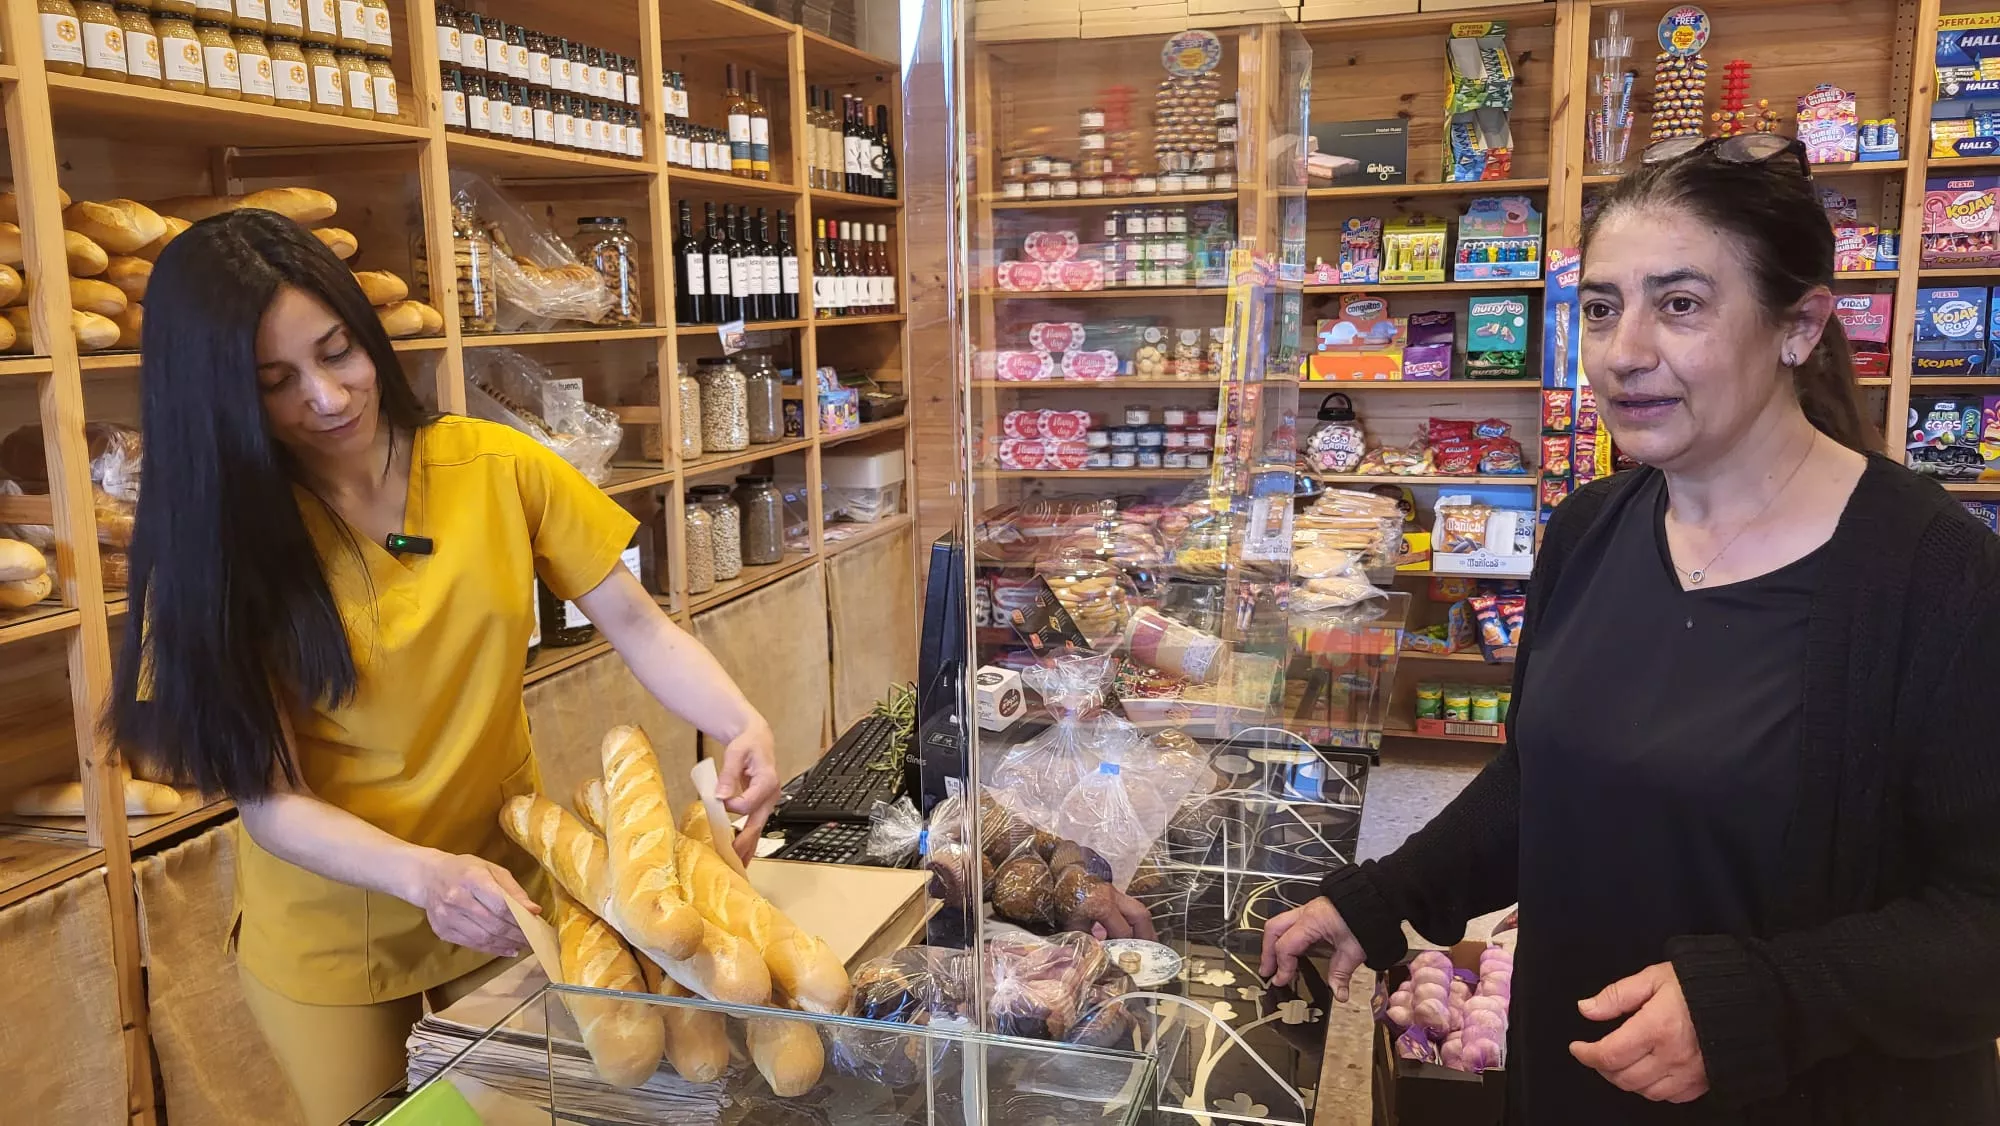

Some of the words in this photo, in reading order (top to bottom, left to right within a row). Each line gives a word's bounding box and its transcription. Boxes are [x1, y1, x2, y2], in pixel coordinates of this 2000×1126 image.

[1675, 17, 1696, 26] FREE
[1965, 82, 1999, 91] HALLS
[1959, 141, 1993, 150] HALLS
[1945, 192, 1995, 219] KOJAK
[1961, 210, 1986, 224] POP
[1932, 306, 1978, 325] KOJAK
[1944, 320, 1970, 331] POP
[1917, 358, 1965, 368] KOJAK
[1924, 420, 1962, 431] EGGS
